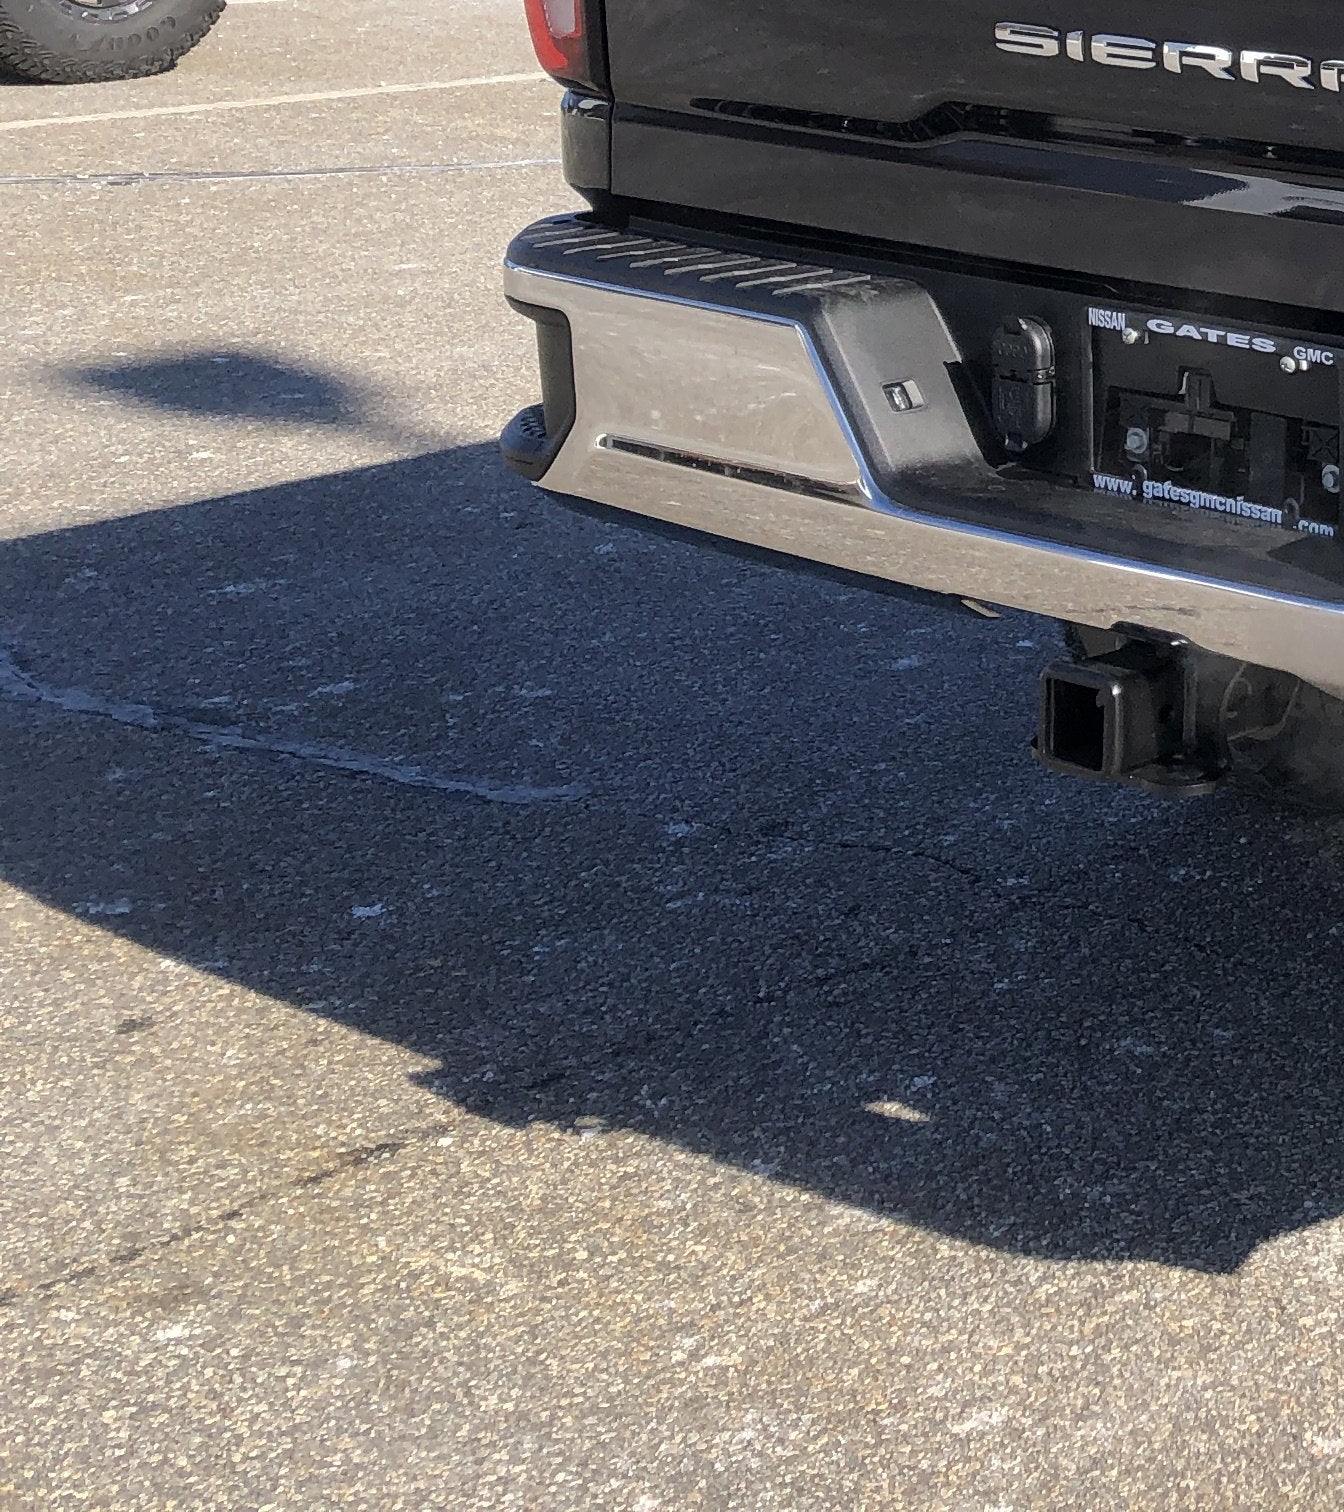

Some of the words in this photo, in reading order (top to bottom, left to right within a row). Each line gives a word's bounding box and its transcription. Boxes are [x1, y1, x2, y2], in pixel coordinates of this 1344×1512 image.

[1088, 306, 1126, 331] NISSAN
[1146, 319, 1277, 354] GATES
[1293, 346, 1334, 365] GMC
